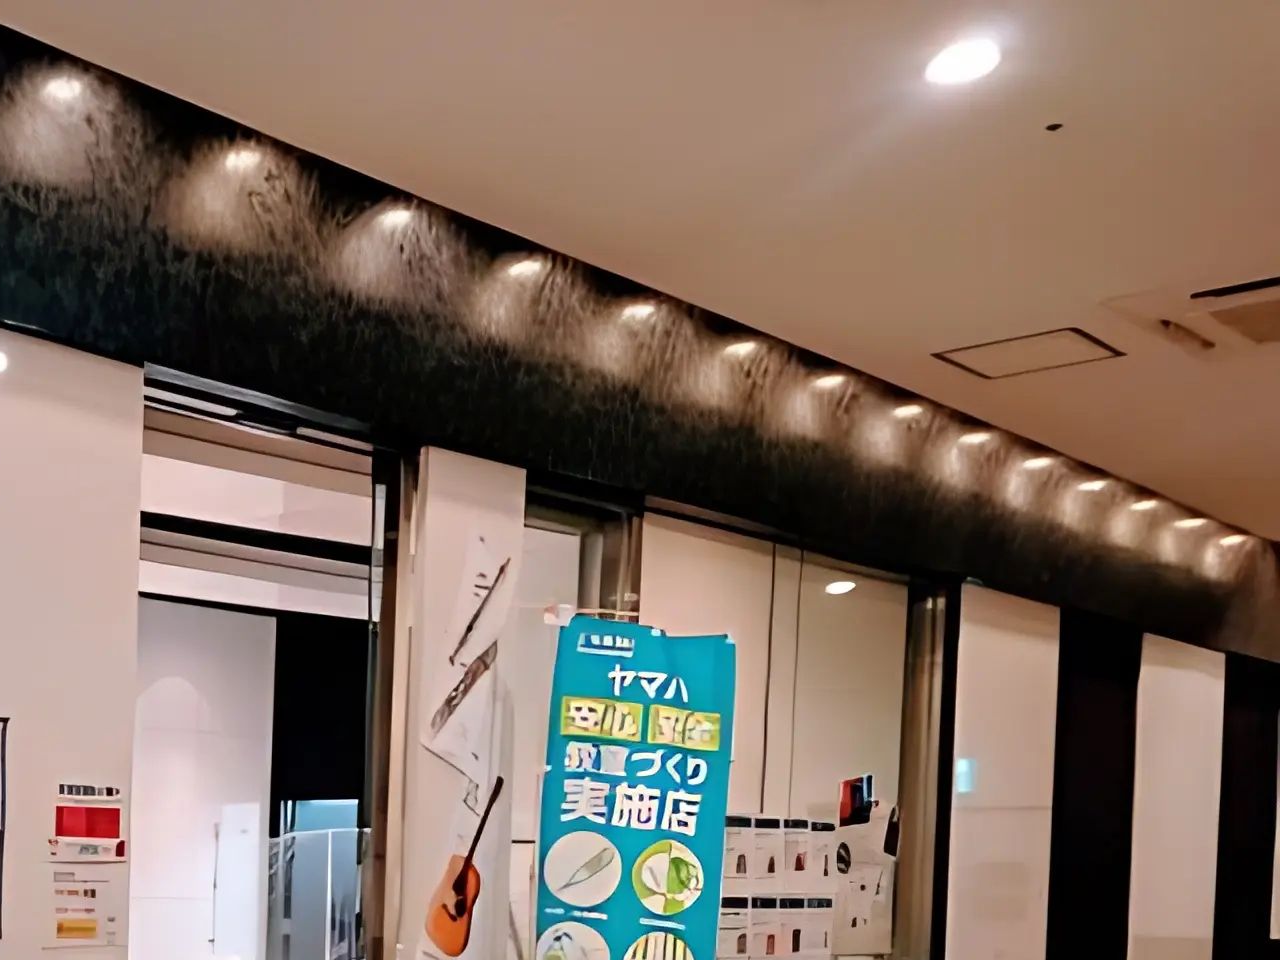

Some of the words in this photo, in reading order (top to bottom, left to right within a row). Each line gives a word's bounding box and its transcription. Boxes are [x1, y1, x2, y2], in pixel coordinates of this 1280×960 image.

[607, 664, 689, 703] ヤマハ
[560, 777, 702, 836] 実施店
